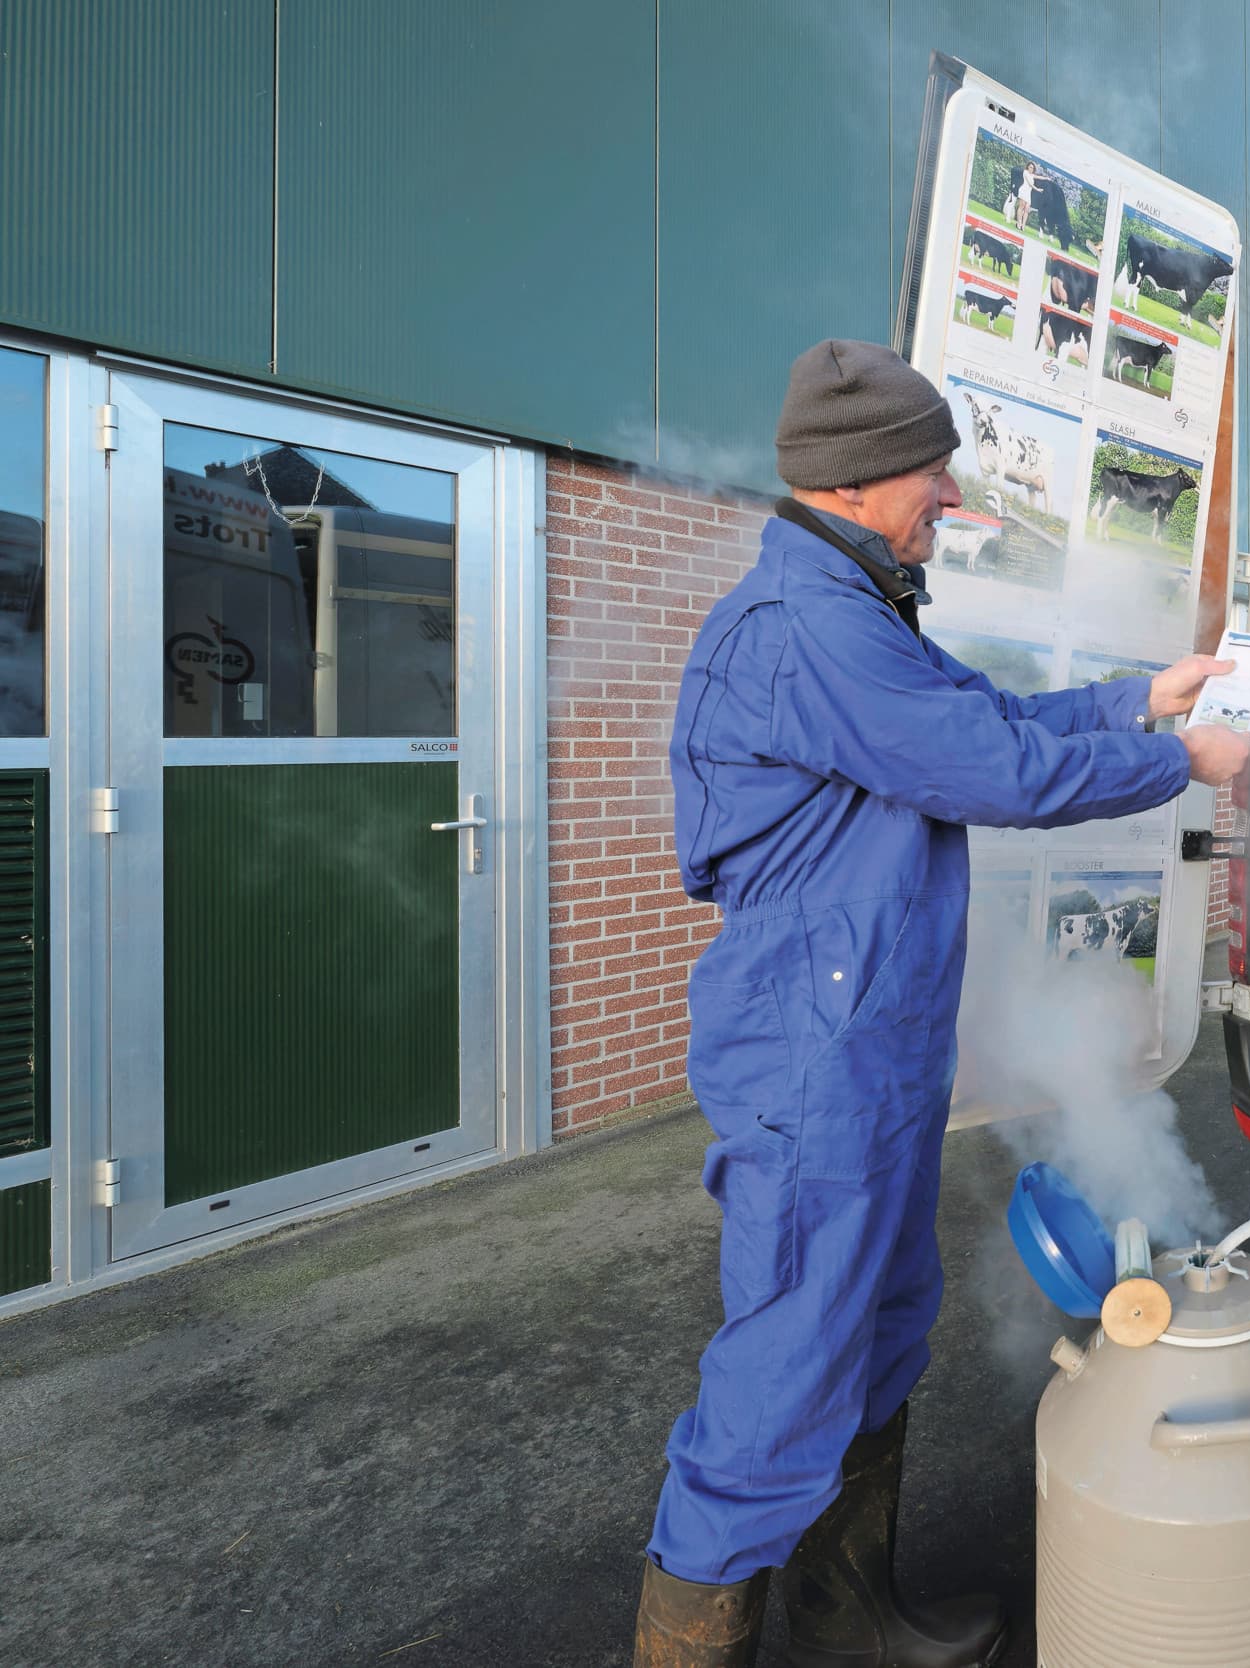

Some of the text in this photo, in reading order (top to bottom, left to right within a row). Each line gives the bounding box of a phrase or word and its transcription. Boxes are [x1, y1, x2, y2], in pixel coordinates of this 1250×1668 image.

[993, 123, 1023, 145] MALKI
[1136, 199, 1161, 218] MALKI
[963, 367, 1018, 394] REPAIRMAN
[1110, 422, 1136, 438] SLASH
[410, 743, 449, 752] SALCO
